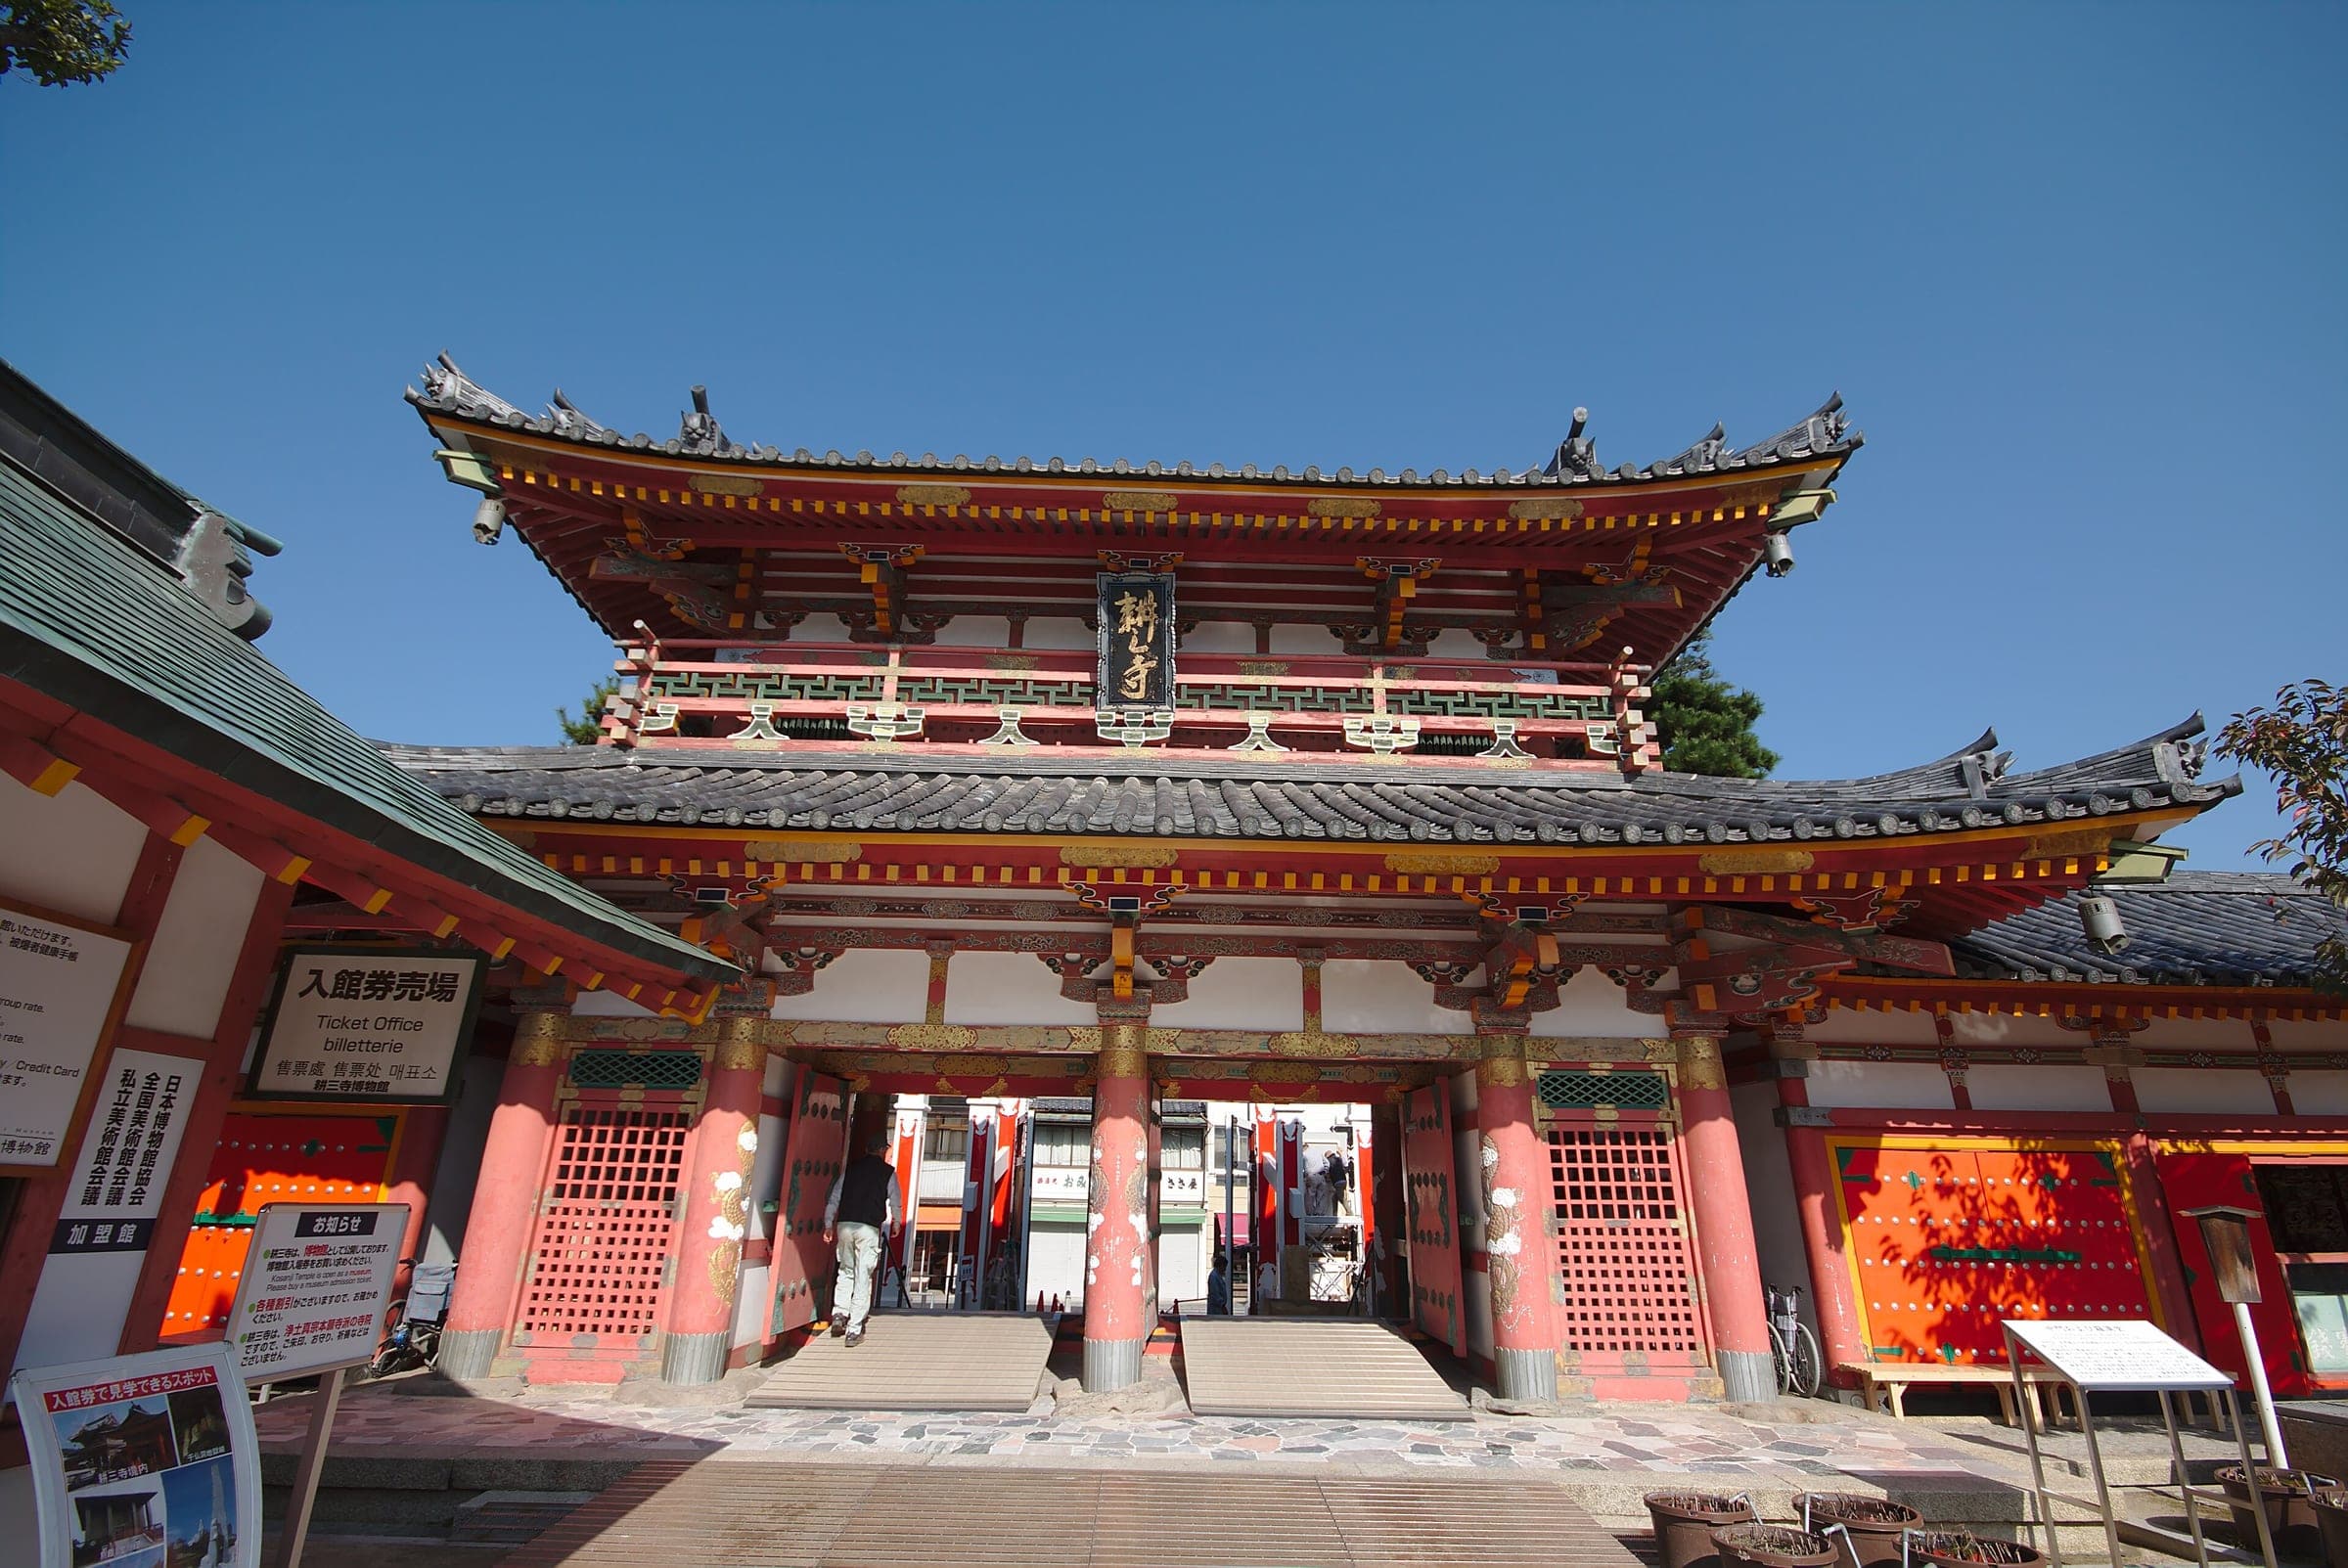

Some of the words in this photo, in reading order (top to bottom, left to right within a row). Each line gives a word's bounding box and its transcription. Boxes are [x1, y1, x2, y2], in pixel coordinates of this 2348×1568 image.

[298, 968, 460, 1003] 入館券売場
[317, 1014, 370, 1031] Ticket
[374, 1016, 424, 1032] Office
[323, 1037, 404, 1053] billetterie
[54, 1065, 80, 1077] Card
[276, 1059, 327, 1077] 售票處
[333, 1061, 383, 1079] 售票处
[388, 1063, 437, 1081] 매표소
[313, 1079, 390, 1094] 耕三寺博物館
[80, 1068, 137, 1206] 私立美術館会議
[105, 1072, 161, 1206] 全国美術館会議
[128, 1075, 182, 1206] 日本博物館協会
[1, 1140, 51, 1155] 博物館
[312, 1215, 362, 1233] お知らせ
[67, 1223, 138, 1245] 加盟館
[251, 1313, 284, 1324] ください。
[240, 1350, 288, 1367] ございません。
[52, 1368, 213, 1411] 入館券で見学できるスポット
